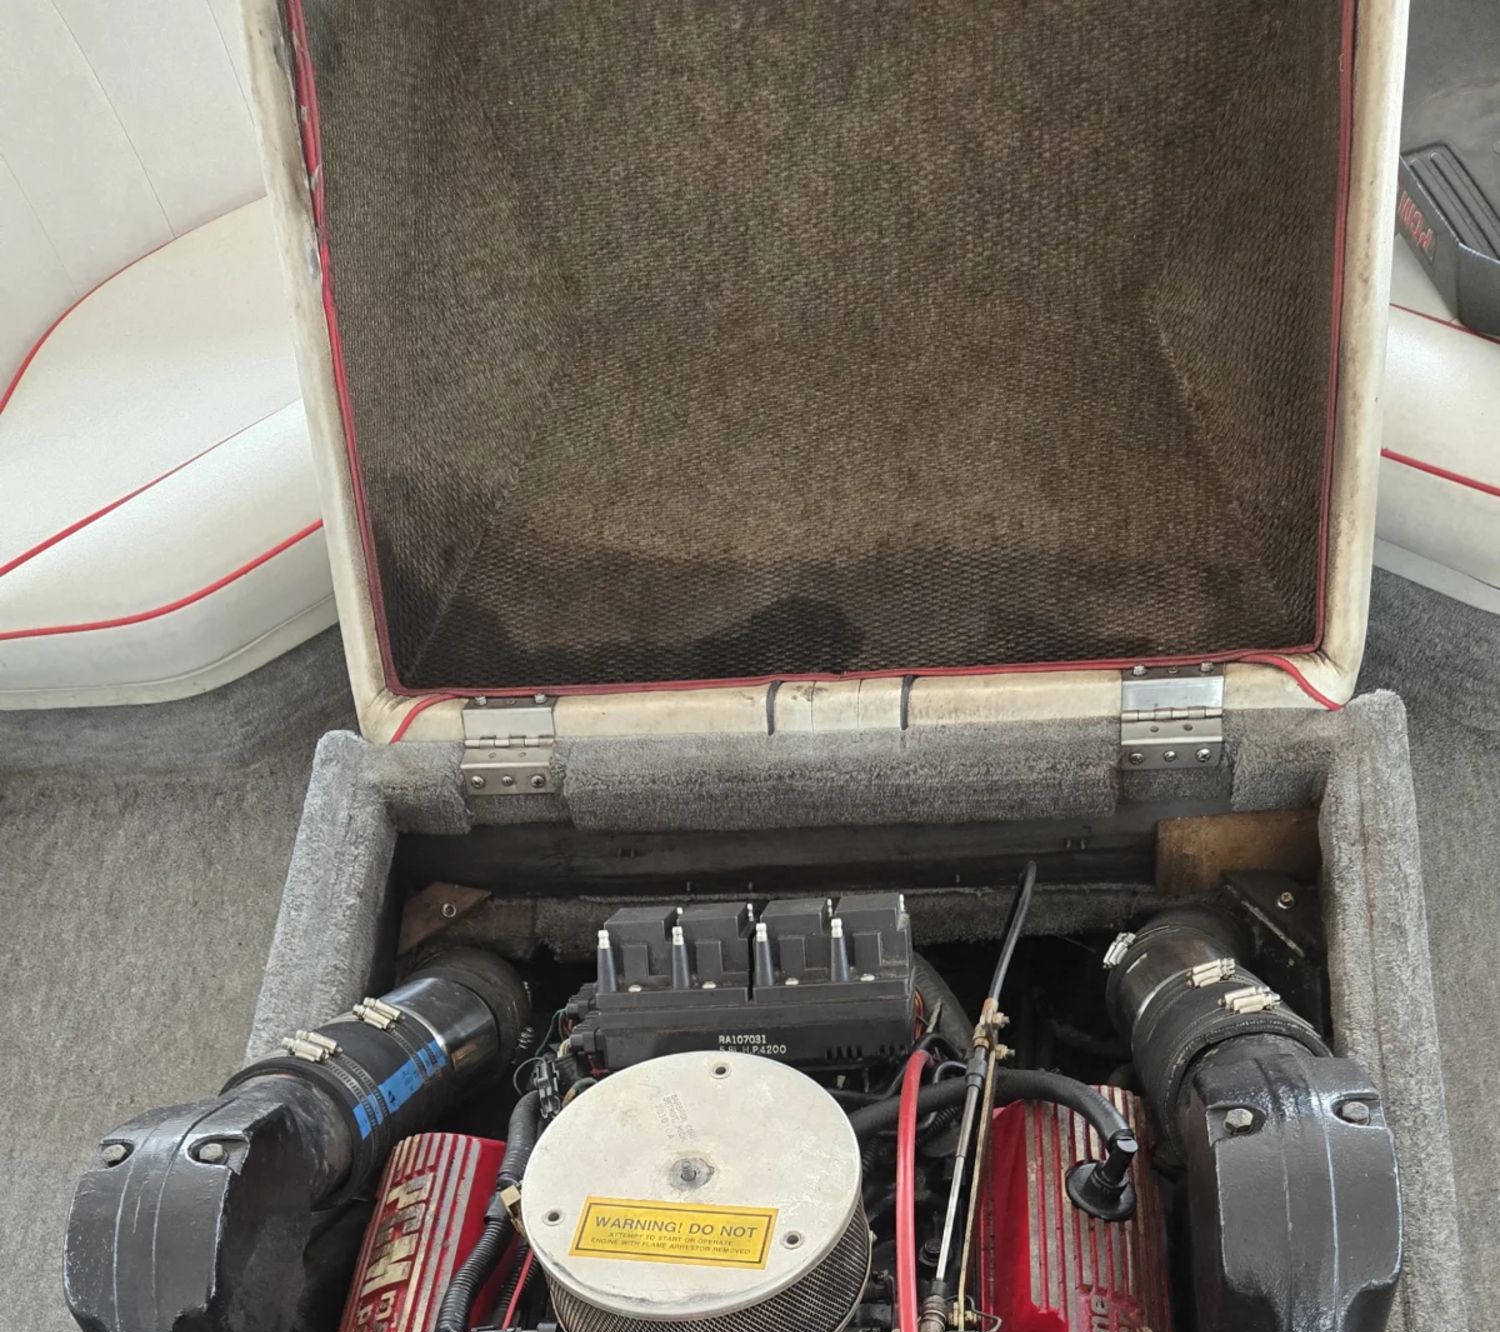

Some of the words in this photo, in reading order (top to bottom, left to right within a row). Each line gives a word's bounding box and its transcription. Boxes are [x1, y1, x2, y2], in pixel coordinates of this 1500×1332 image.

[718, 1034, 767, 1045] RA107031
[360, 1172, 434, 1298] PCM
[596, 1216, 682, 1233] WARNING!
[688, 1223, 714, 1236] DO
[720, 1225, 758, 1239] NOT
[591, 1237, 619, 1246] ENGINE
[642, 1241, 667, 1250] FLAME
[669, 1243, 711, 1252] ARRESTOR
[713, 1246, 751, 1255] REMOVED
[608, 1232, 643, 1240] ATTEMPT
[658, 1235, 682, 1243] START
[697, 1238, 734, 1247] OPERATE
